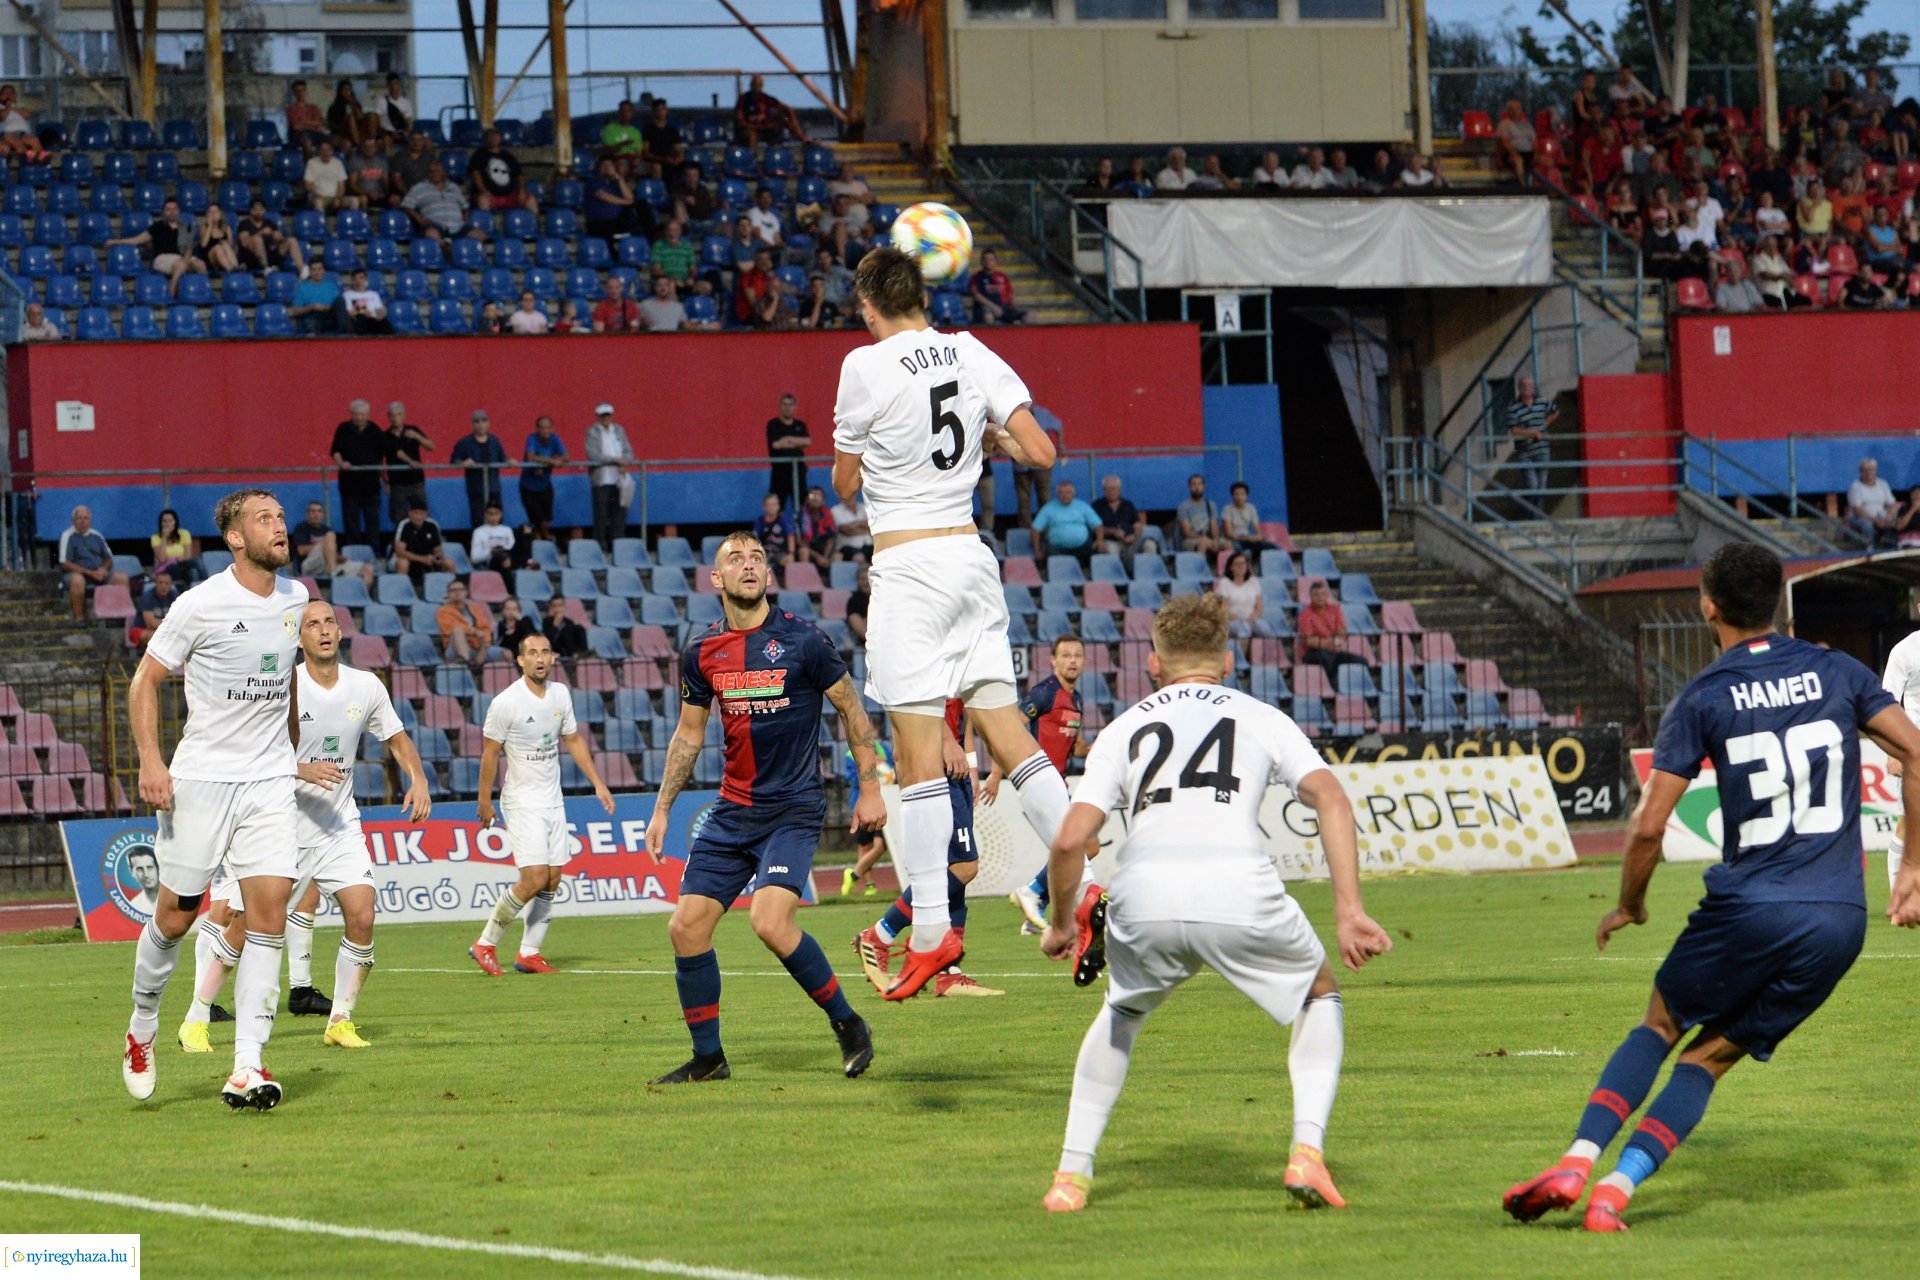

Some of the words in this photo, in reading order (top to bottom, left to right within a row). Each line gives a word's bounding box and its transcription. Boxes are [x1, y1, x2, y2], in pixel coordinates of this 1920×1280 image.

[1222, 311, 1235, 328] A
[930, 380, 965, 470] 5
[1138, 688, 1232, 713] DOROG
[1730, 672, 1823, 710] HAMED
[1128, 717, 1240, 817] 24
[1725, 719, 1844, 848] 30
[447, 819, 647, 863] JÓSEF
[957, 827, 970, 852] 4
[768, 866, 789, 874] JAKO
[471, 870, 668, 909] ADÉMIA
